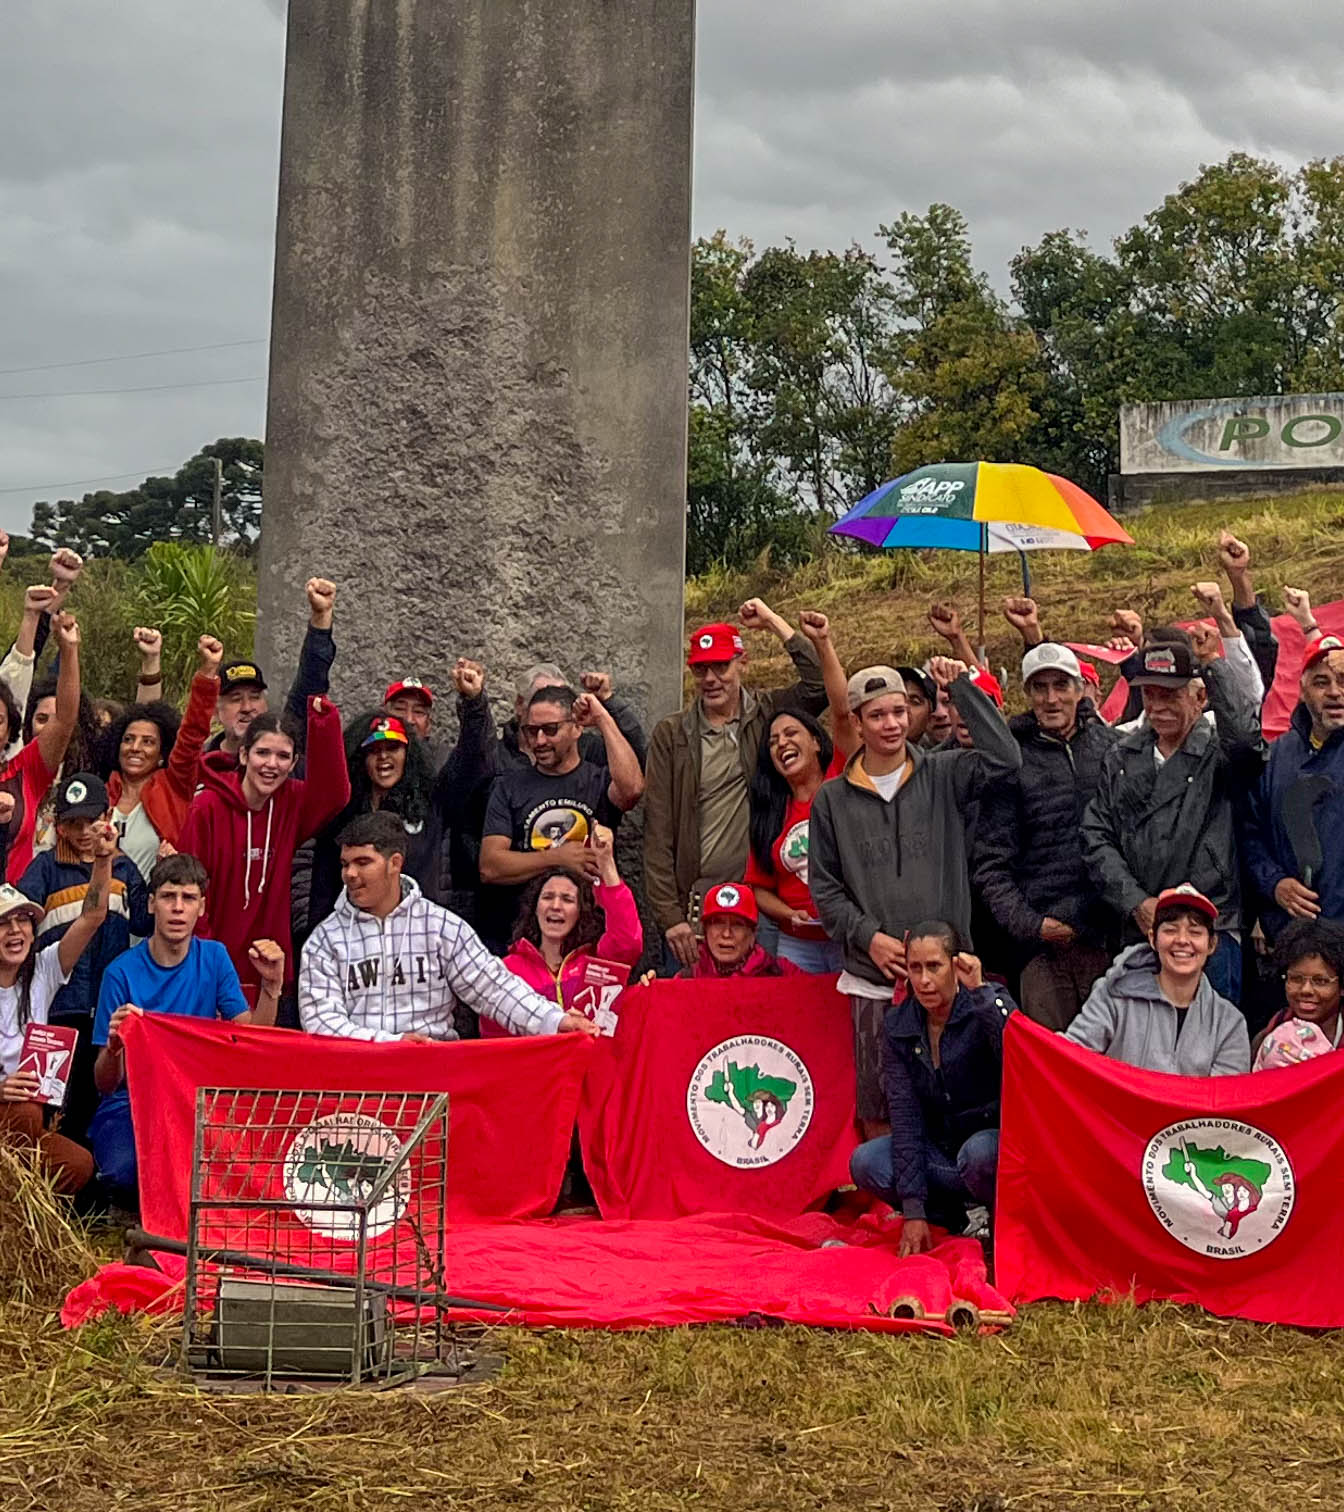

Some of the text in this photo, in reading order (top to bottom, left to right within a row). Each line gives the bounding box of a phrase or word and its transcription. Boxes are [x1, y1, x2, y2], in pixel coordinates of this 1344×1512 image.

[918, 480, 965, 496] APP
[348, 951, 445, 992] AWAII
[690, 1037, 812, 1144] MOVIMENTO DOS TRABALHADORES RURAIS SEM TERRA
[736, 1155, 770, 1166] BRASIL
[1146, 1120, 1292, 1231] MOVIMENTO DOS TRABALHADORES RURAIS SEM TERRA
[1206, 1244, 1246, 1256] BRASIL
